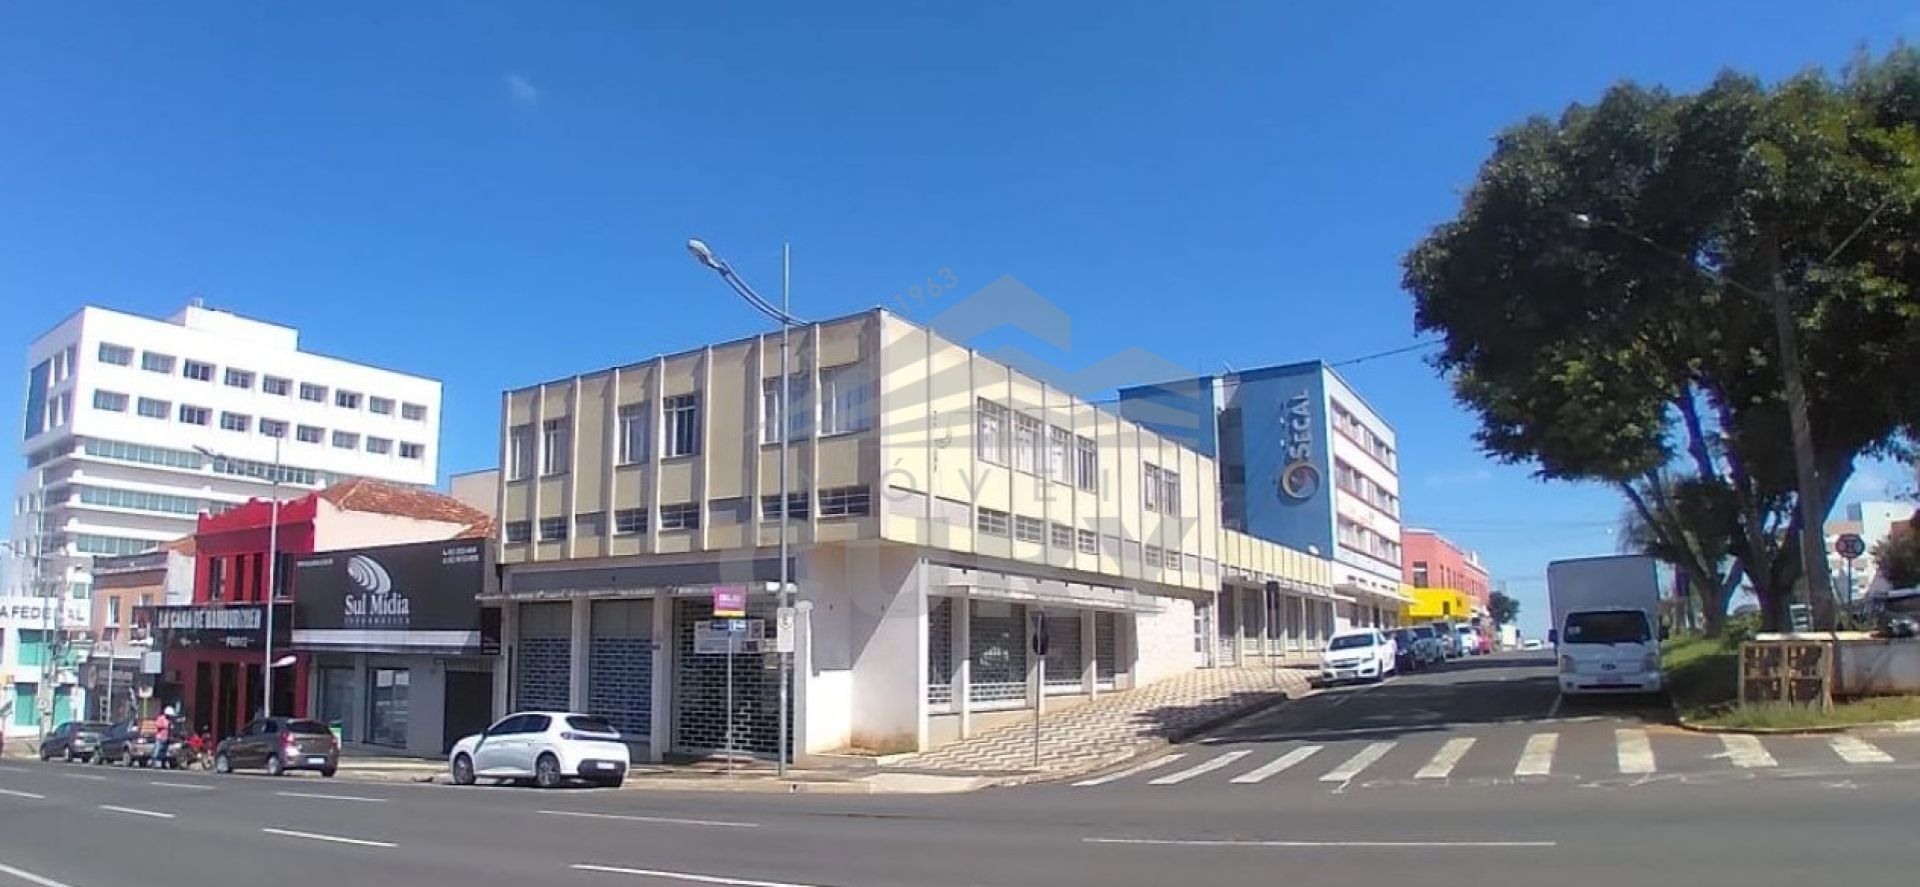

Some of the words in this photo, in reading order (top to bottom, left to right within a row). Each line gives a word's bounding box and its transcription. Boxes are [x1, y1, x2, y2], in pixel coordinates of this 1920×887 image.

[1289, 389, 1311, 459] SECAL
[11, 604, 85, 621] FEDEAL
[345, 595, 367, 615] Sul
